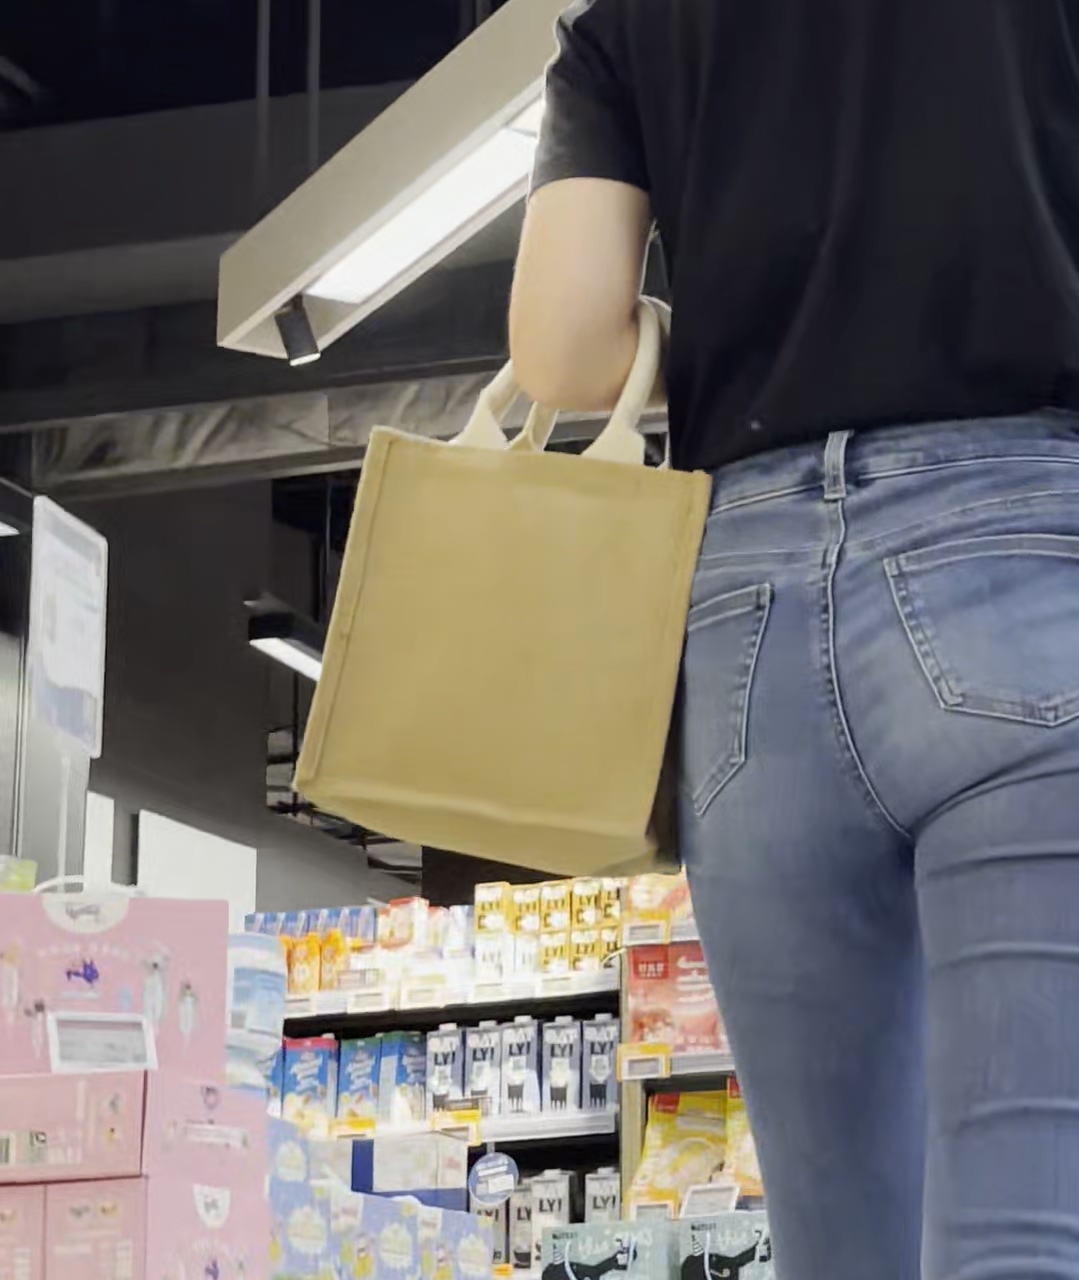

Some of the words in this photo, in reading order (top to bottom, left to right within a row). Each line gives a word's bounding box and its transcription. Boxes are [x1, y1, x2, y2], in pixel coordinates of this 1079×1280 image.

[472, 1047, 495, 1062] LY!
[508, 1040, 532, 1056] LY!
[550, 1042, 574, 1058] LY!
[590, 1040, 614, 1055] LY!
[433, 1051, 456, 1066] LY!
[539, 1198, 562, 1213] LY!
